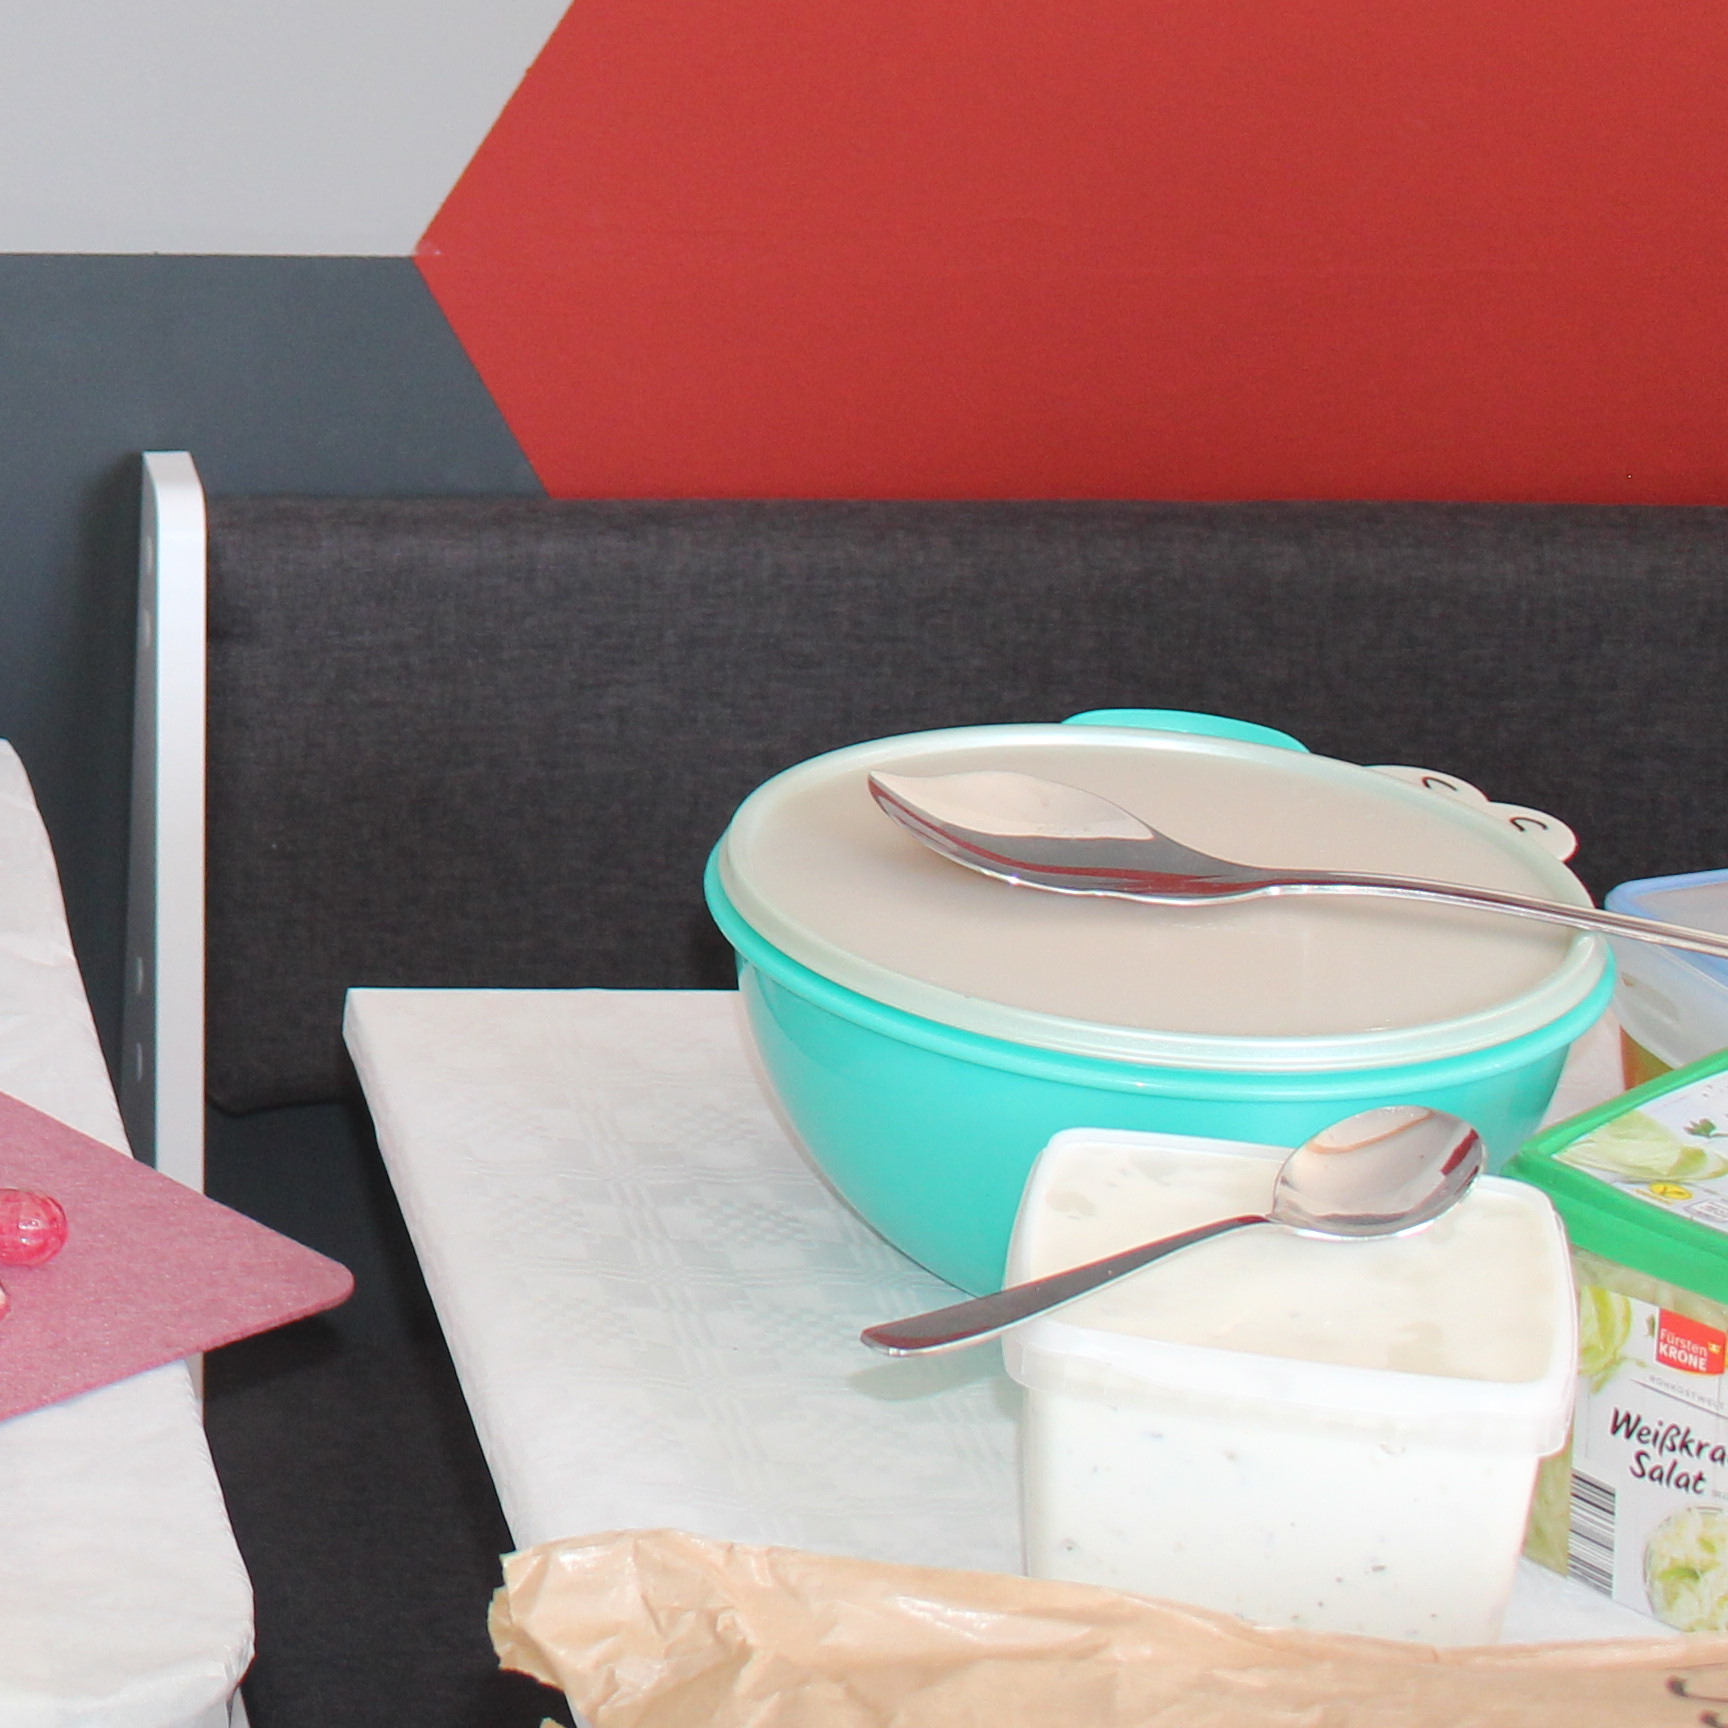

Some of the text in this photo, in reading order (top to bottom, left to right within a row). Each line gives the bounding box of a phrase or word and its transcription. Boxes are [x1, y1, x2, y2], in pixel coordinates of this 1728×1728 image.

[1658, 1342, 1708, 1372] KRONE
[1659, 1327, 1708, 1358] Fürsten
[1610, 1406, 1728, 1469] Weißkra
[1629, 1449, 1707, 1495] Salat
